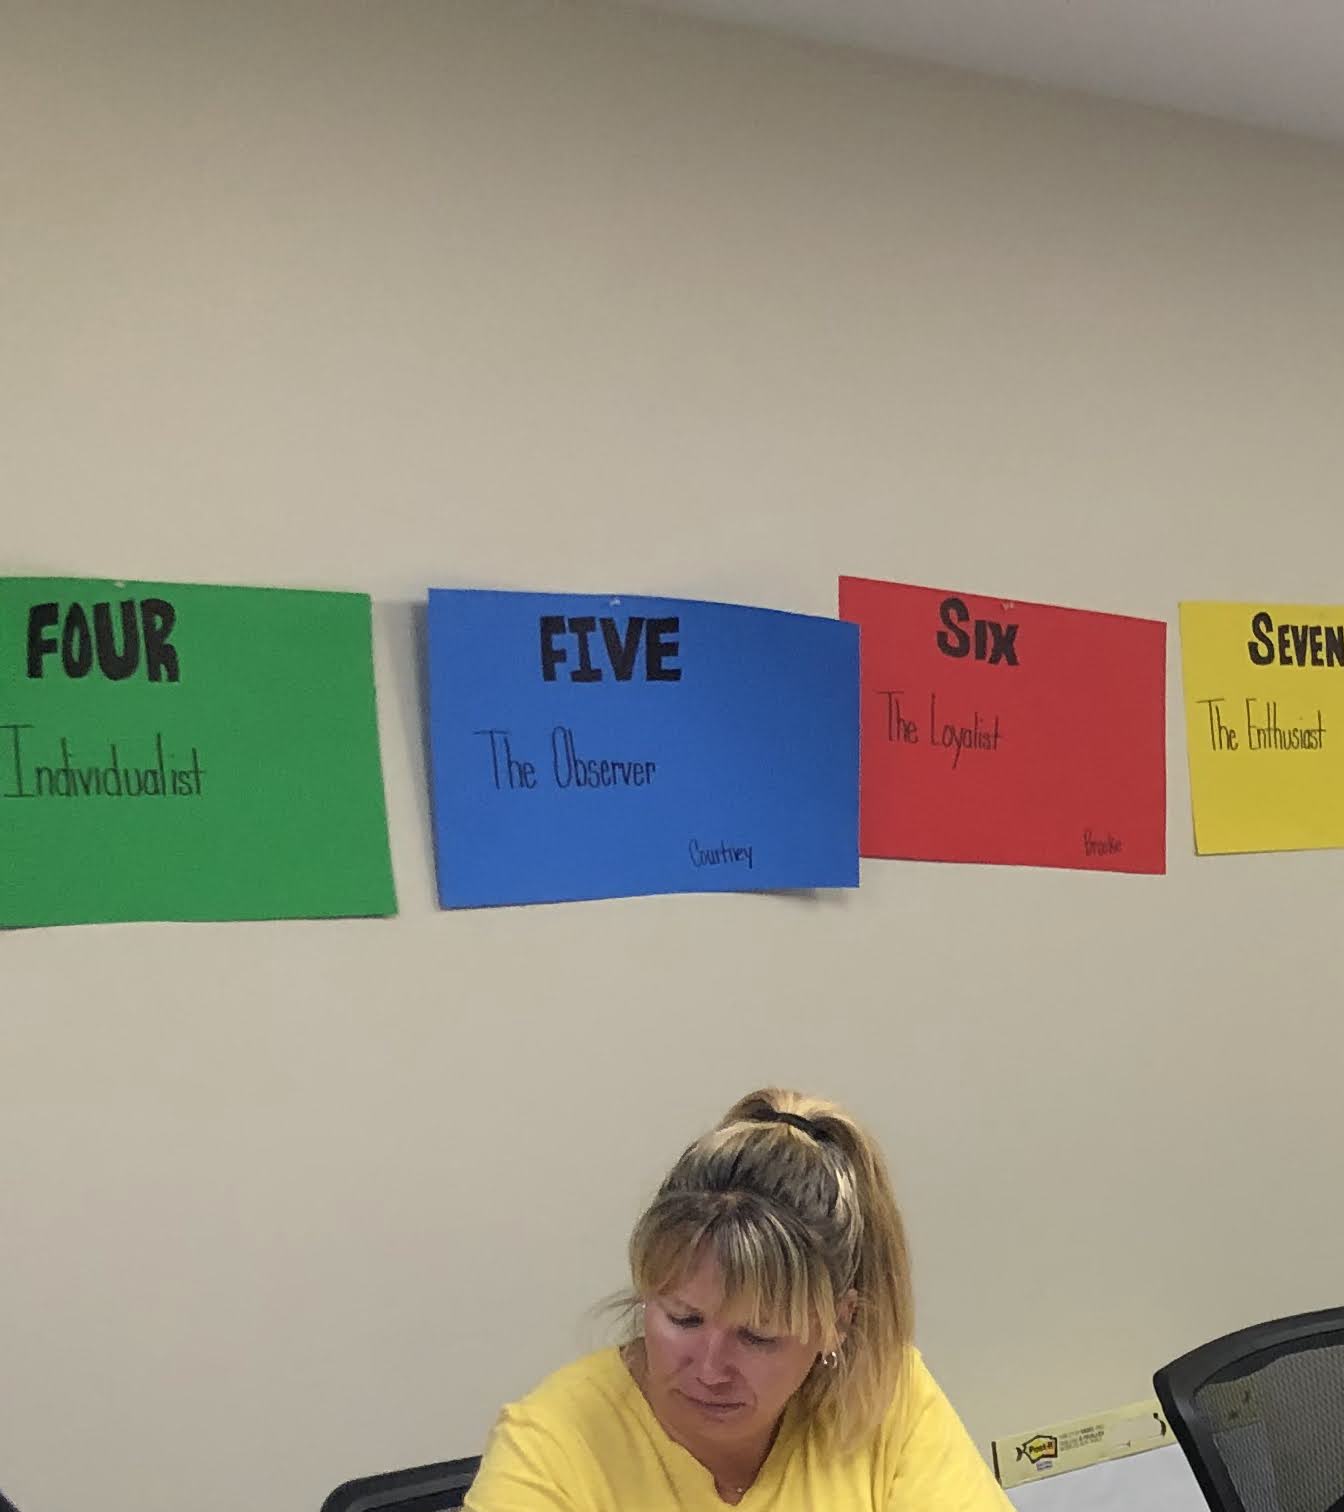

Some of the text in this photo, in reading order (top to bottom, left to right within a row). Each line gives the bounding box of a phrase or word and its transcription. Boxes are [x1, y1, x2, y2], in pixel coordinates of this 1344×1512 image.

[27, 598, 180, 683] FOUR
[540, 615, 682, 683] FIVE
[472, 725, 657, 790] The Observer
[876, 690, 1003, 770] The Loyalist
[1196, 698, 1327, 752] The Enthusiast
[0, 723, 206, 798] Individualist
[687, 838, 754, 870] Courtney
